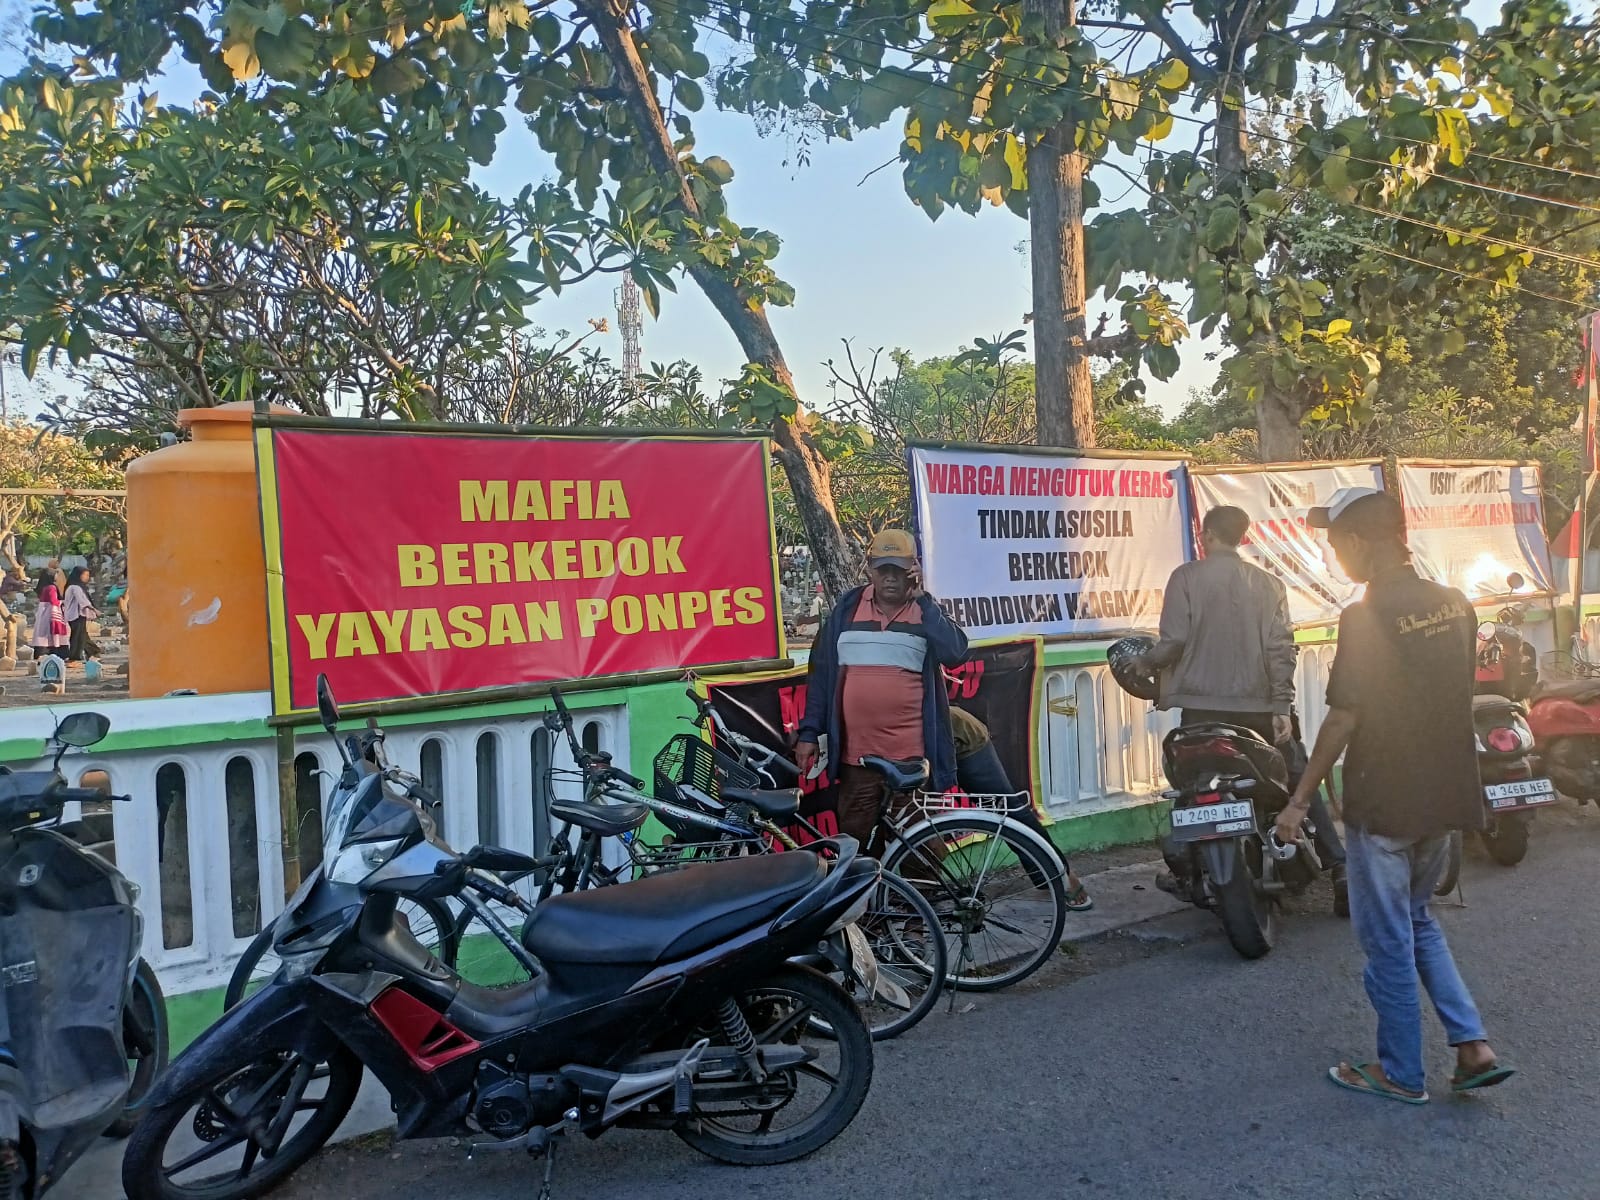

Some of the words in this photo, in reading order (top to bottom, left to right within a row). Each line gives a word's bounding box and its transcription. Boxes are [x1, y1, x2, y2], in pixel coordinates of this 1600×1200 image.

[926, 463, 1005, 496] WARGA
[1010, 466, 1116, 498] MENGUTUK
[1119, 469, 1174, 498] KERAS
[459, 479, 630, 522] MAFIA
[978, 509, 1050, 539] TINDAK
[1054, 510, 1134, 538] ASUSILA
[397, 535, 687, 587] BERKEDOK
[1008, 550, 1110, 582] BERKEDOK
[295, 600, 562, 660] YAYASAN
[577, 586, 766, 638] PONPES
[1175, 813, 1183, 825] W
